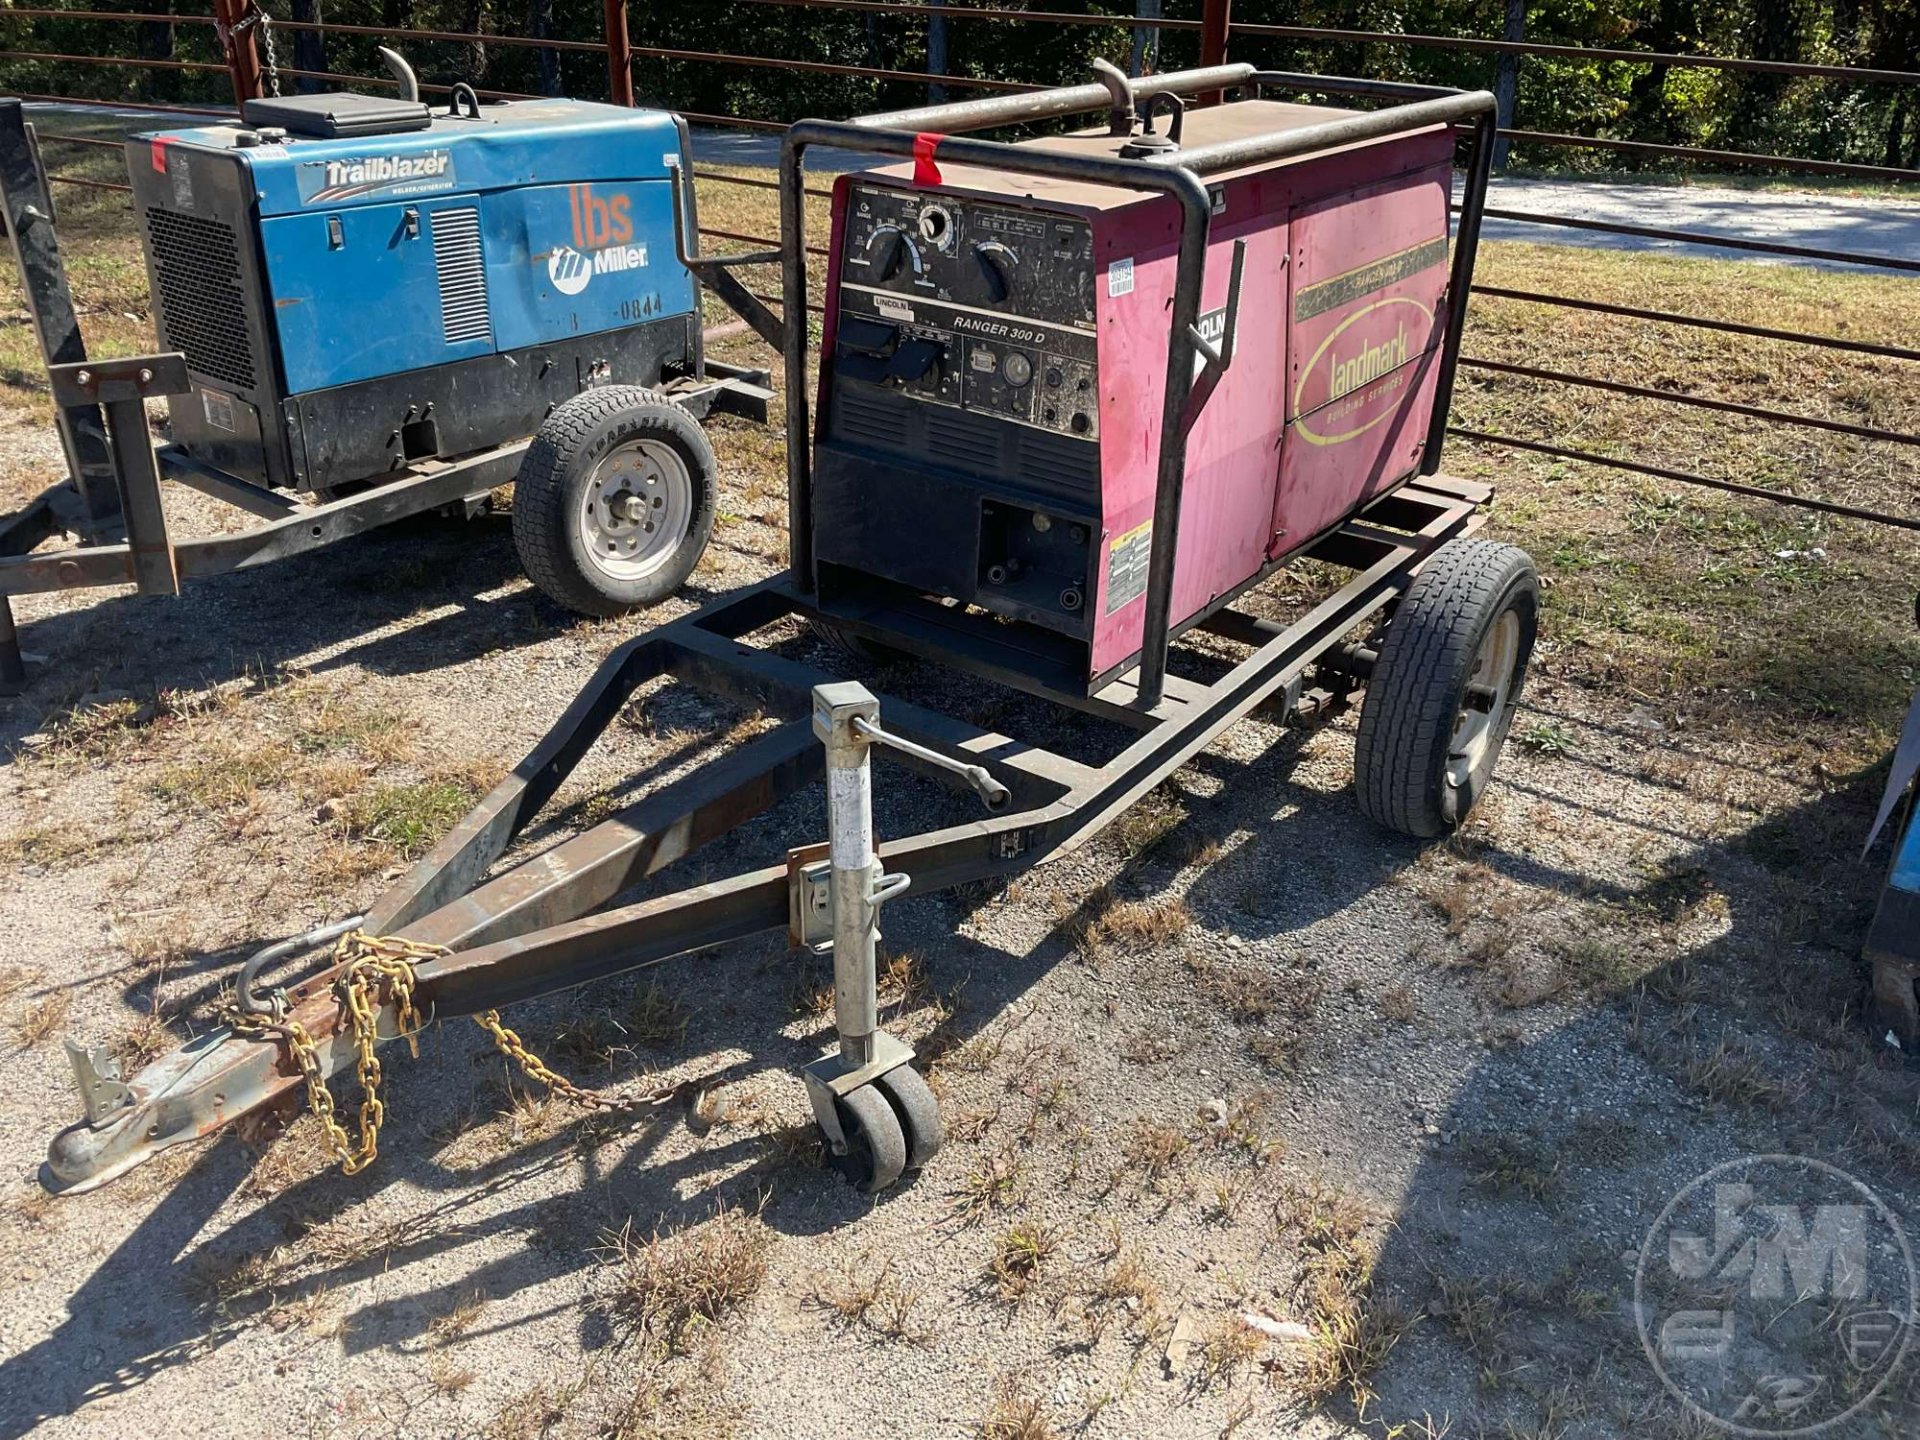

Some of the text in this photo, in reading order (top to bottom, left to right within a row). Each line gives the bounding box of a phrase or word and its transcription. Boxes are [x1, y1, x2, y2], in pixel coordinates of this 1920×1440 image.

[326, 155, 448, 186] Trailblazer
[875, 297, 908, 311] LINCOLN
[953, 315, 1008, 336] RANGER
[1009, 327, 1034, 342] 300
[1033, 331, 1046, 344] D
[1330, 320, 1408, 399] landmark
